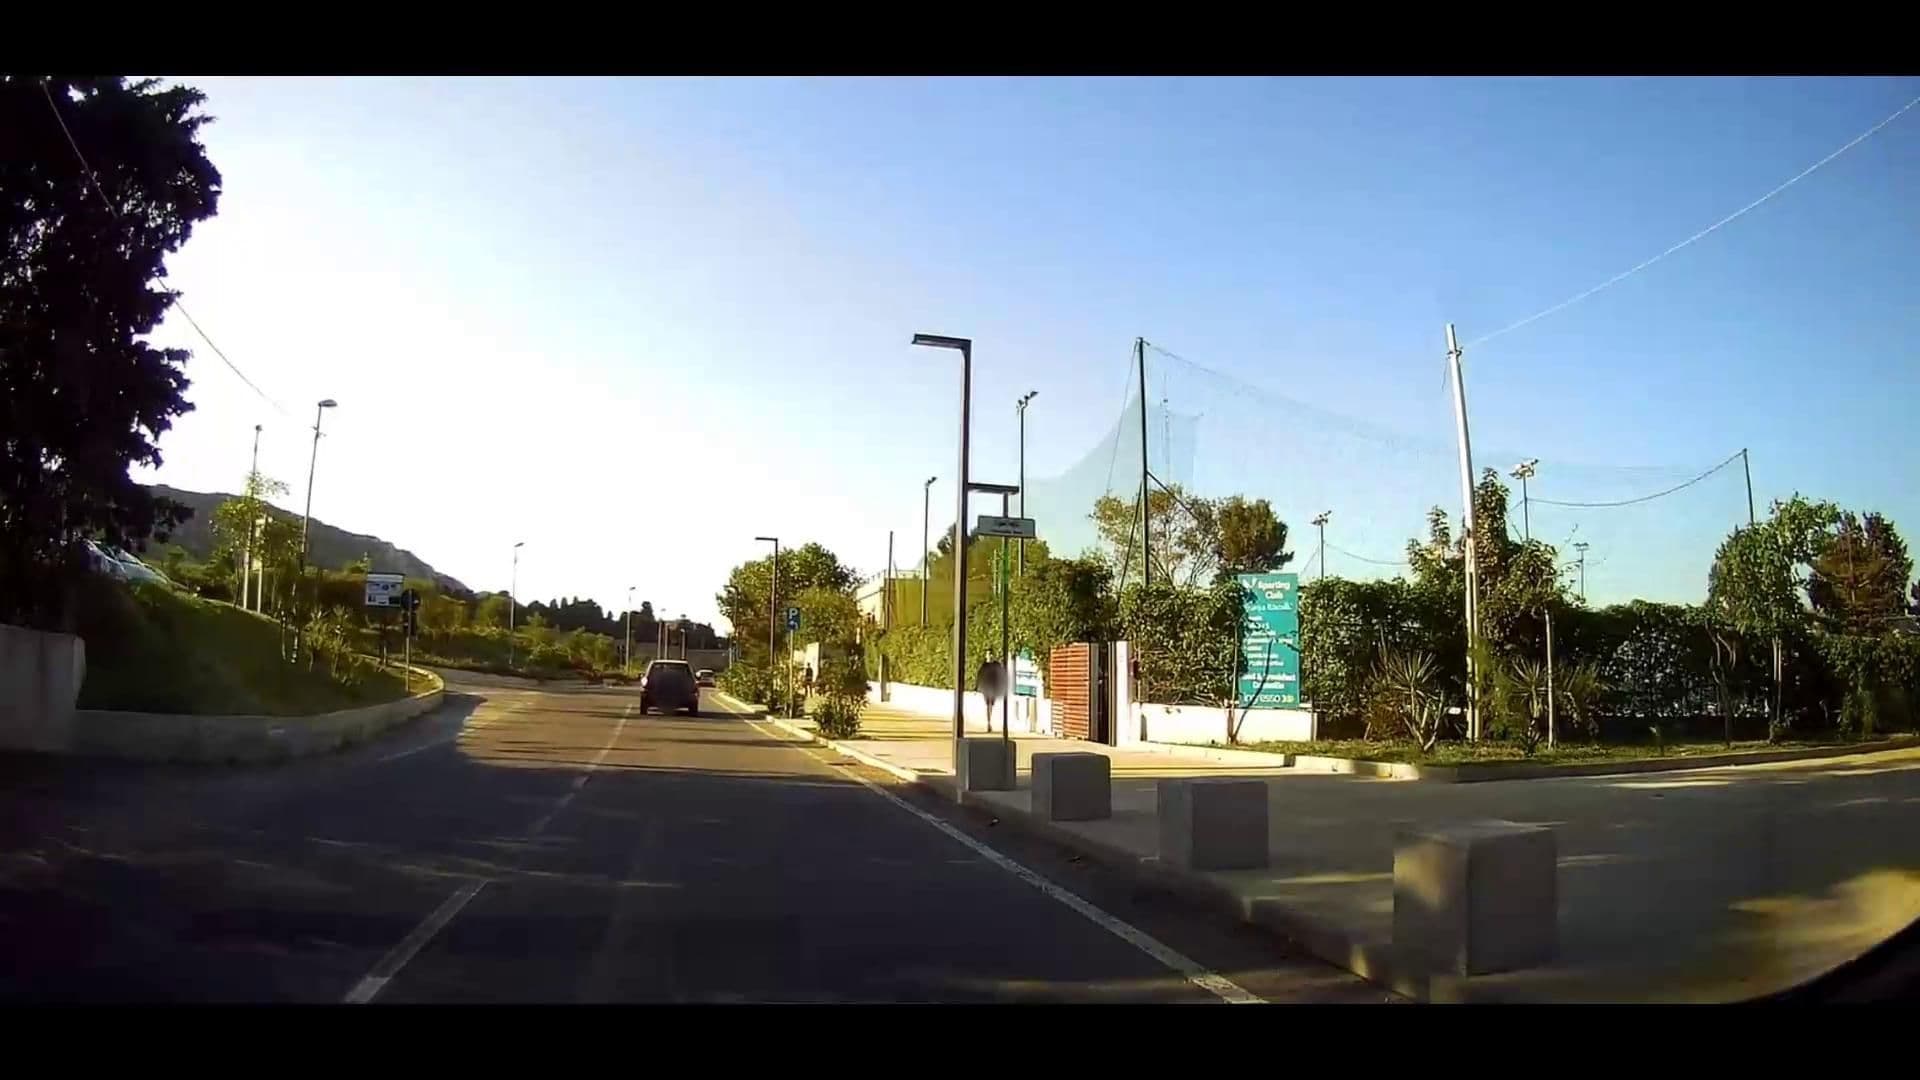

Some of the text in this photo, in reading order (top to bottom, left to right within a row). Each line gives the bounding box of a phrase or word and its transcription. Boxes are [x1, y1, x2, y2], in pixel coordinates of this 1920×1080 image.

[1258, 581, 1290, 591] Sporting
[1265, 590, 1284, 600] Club
[789, 607, 798, 619] P
